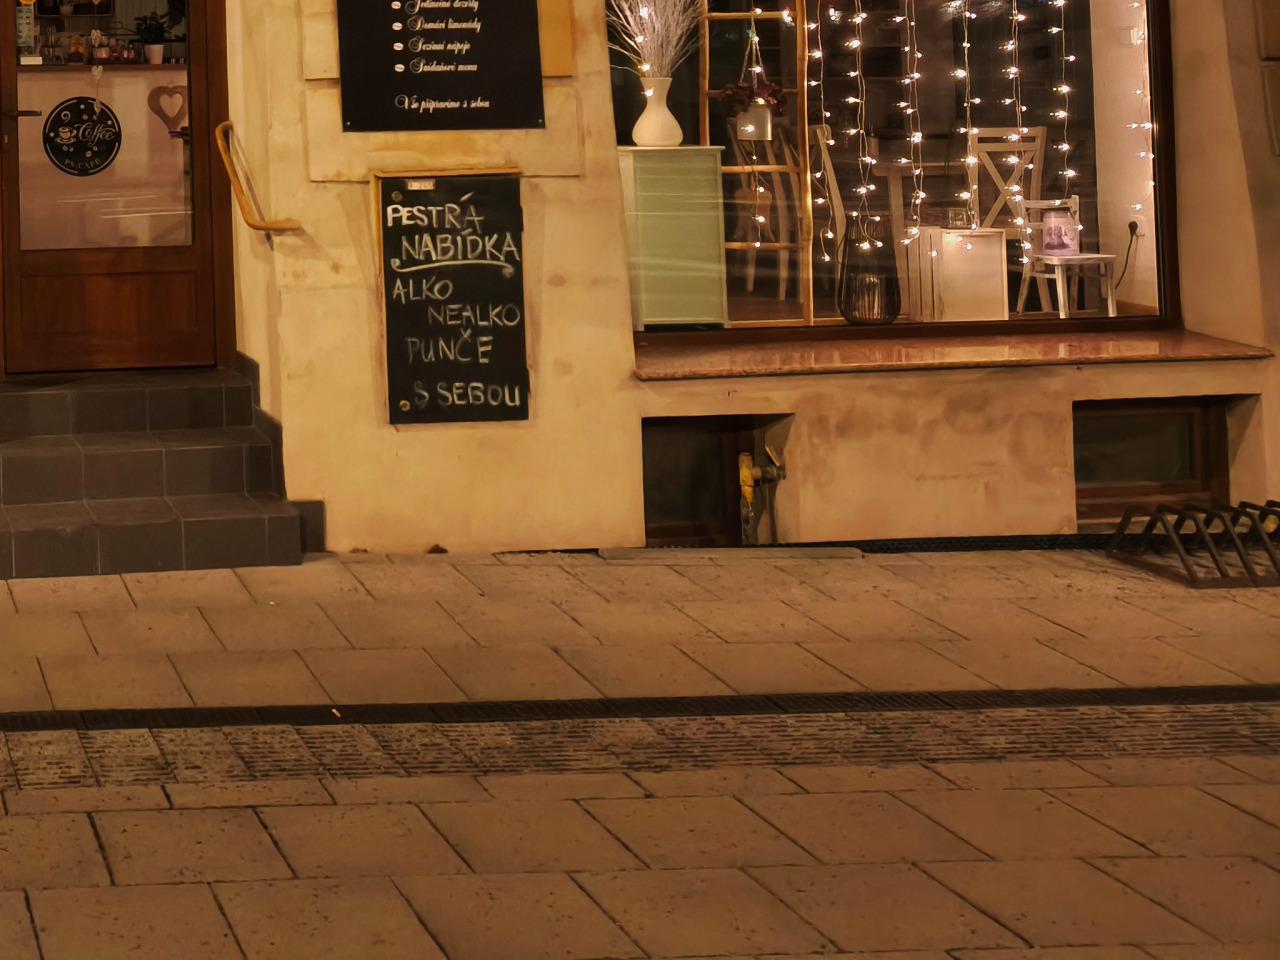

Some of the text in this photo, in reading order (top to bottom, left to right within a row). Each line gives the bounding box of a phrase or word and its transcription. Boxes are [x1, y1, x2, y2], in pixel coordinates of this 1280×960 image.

[74, 122, 116, 147] Coffee
[386, 192, 484, 234] PESTRÁ
[401, 229, 520, 262] NABÍDKA
[392, 276, 453, 304] ALKO
[427, 304, 520, 327] NEALKO
[407, 328, 493, 365] PUNČE
[437, 382, 520, 407] SEBOU
